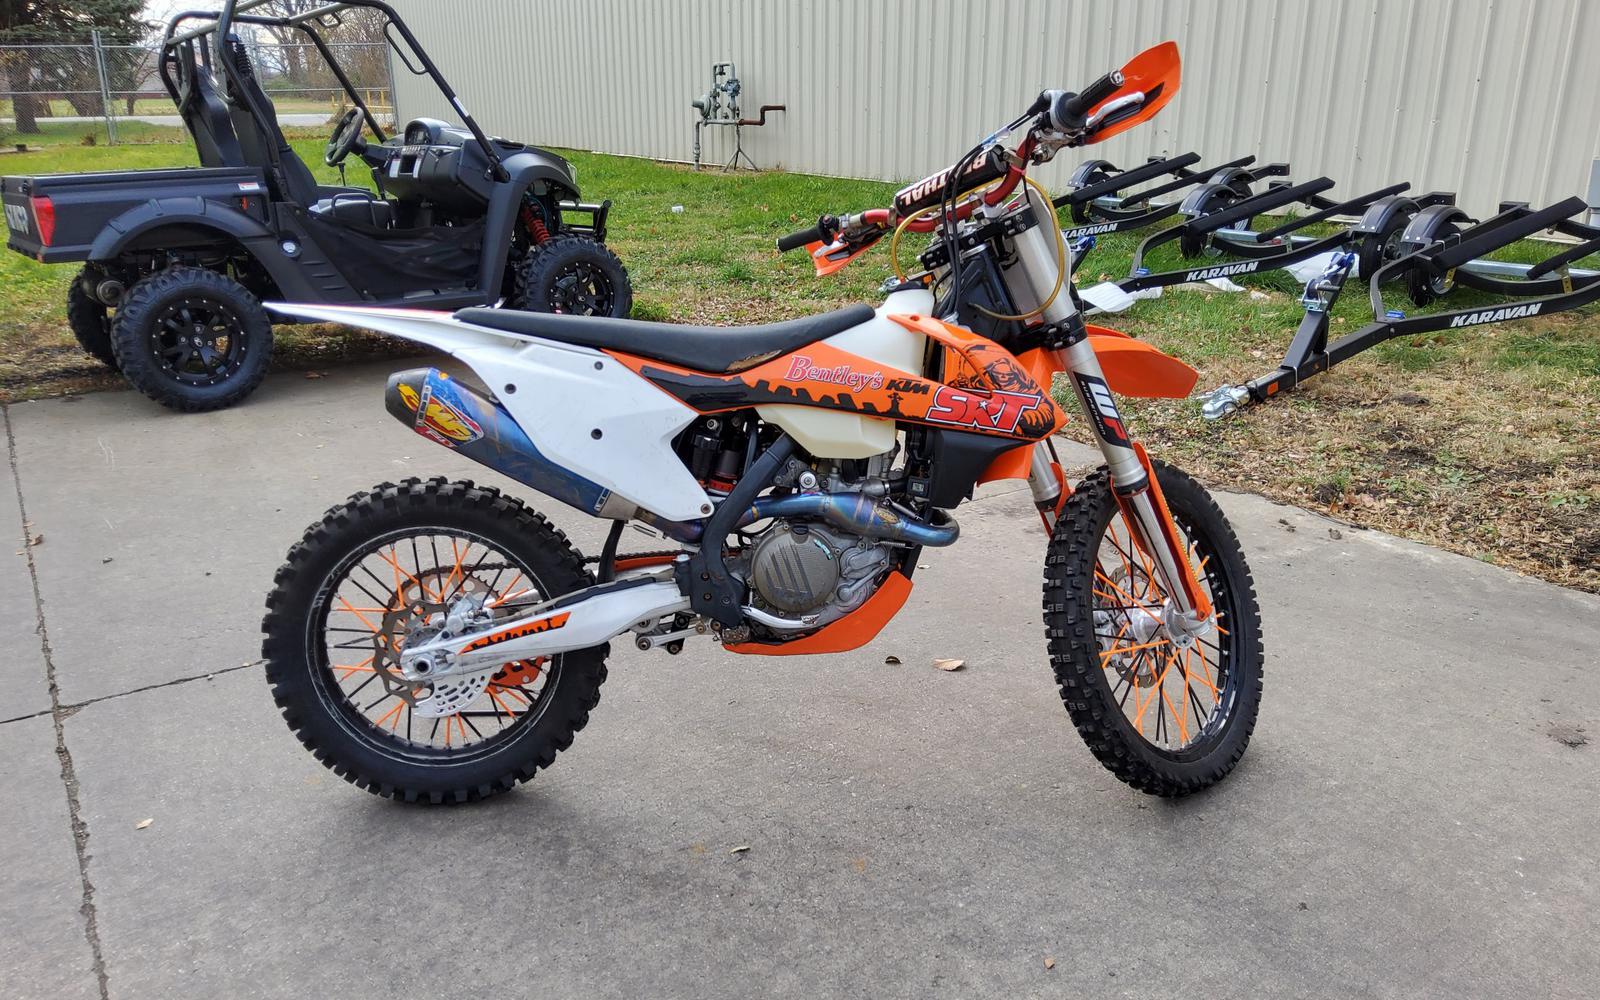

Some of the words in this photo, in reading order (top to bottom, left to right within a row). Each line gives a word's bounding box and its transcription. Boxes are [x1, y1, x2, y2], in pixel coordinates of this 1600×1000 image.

[900, 153, 987, 206] RTHAL
[1186, 262, 1258, 281] KARAVAN
[1450, 303, 1542, 327] KARAVAN
[784, 354, 884, 393] Bentley's
[885, 378, 930, 395] KTM
